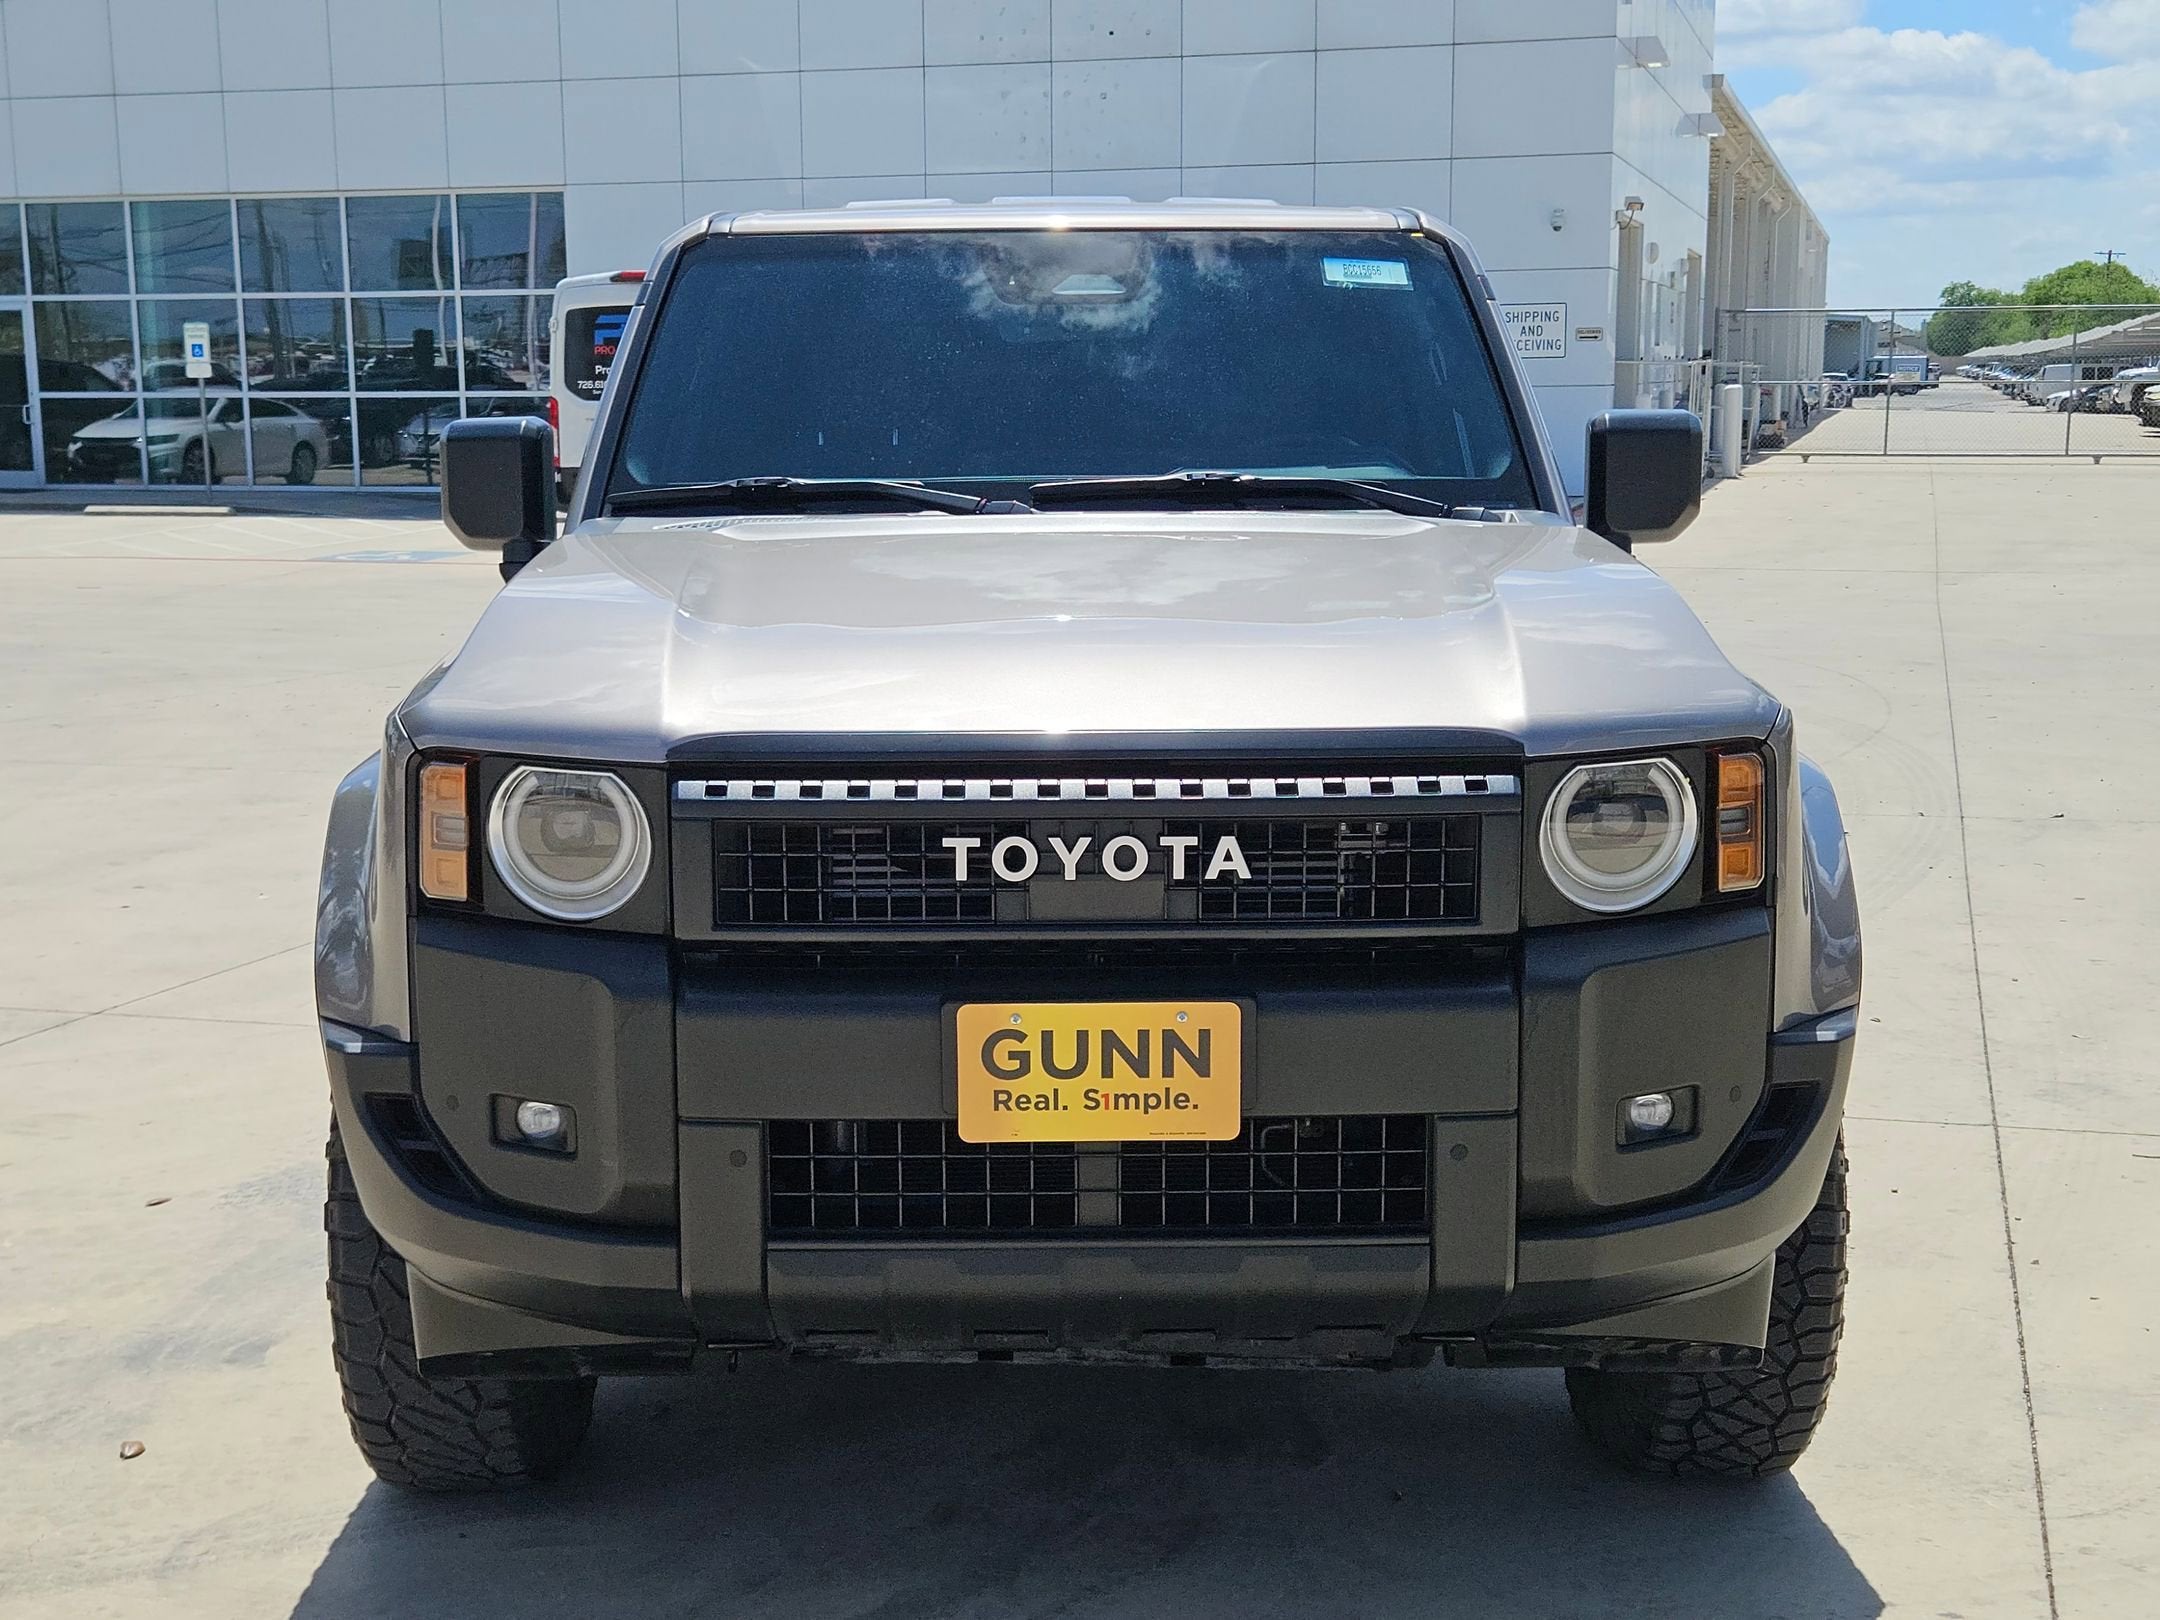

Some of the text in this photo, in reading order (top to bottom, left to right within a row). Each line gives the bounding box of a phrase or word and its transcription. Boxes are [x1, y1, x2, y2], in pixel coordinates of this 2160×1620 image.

[1505, 310, 1560, 323] SHIPPING
[1520, 325, 1543, 337] AND
[1515, 339, 1562, 351] CEIVING
[942, 835, 1252, 882] TOYOTA
[980, 1028, 1211, 1081] GUNN
[993, 1088, 1069, 1112] Real.
